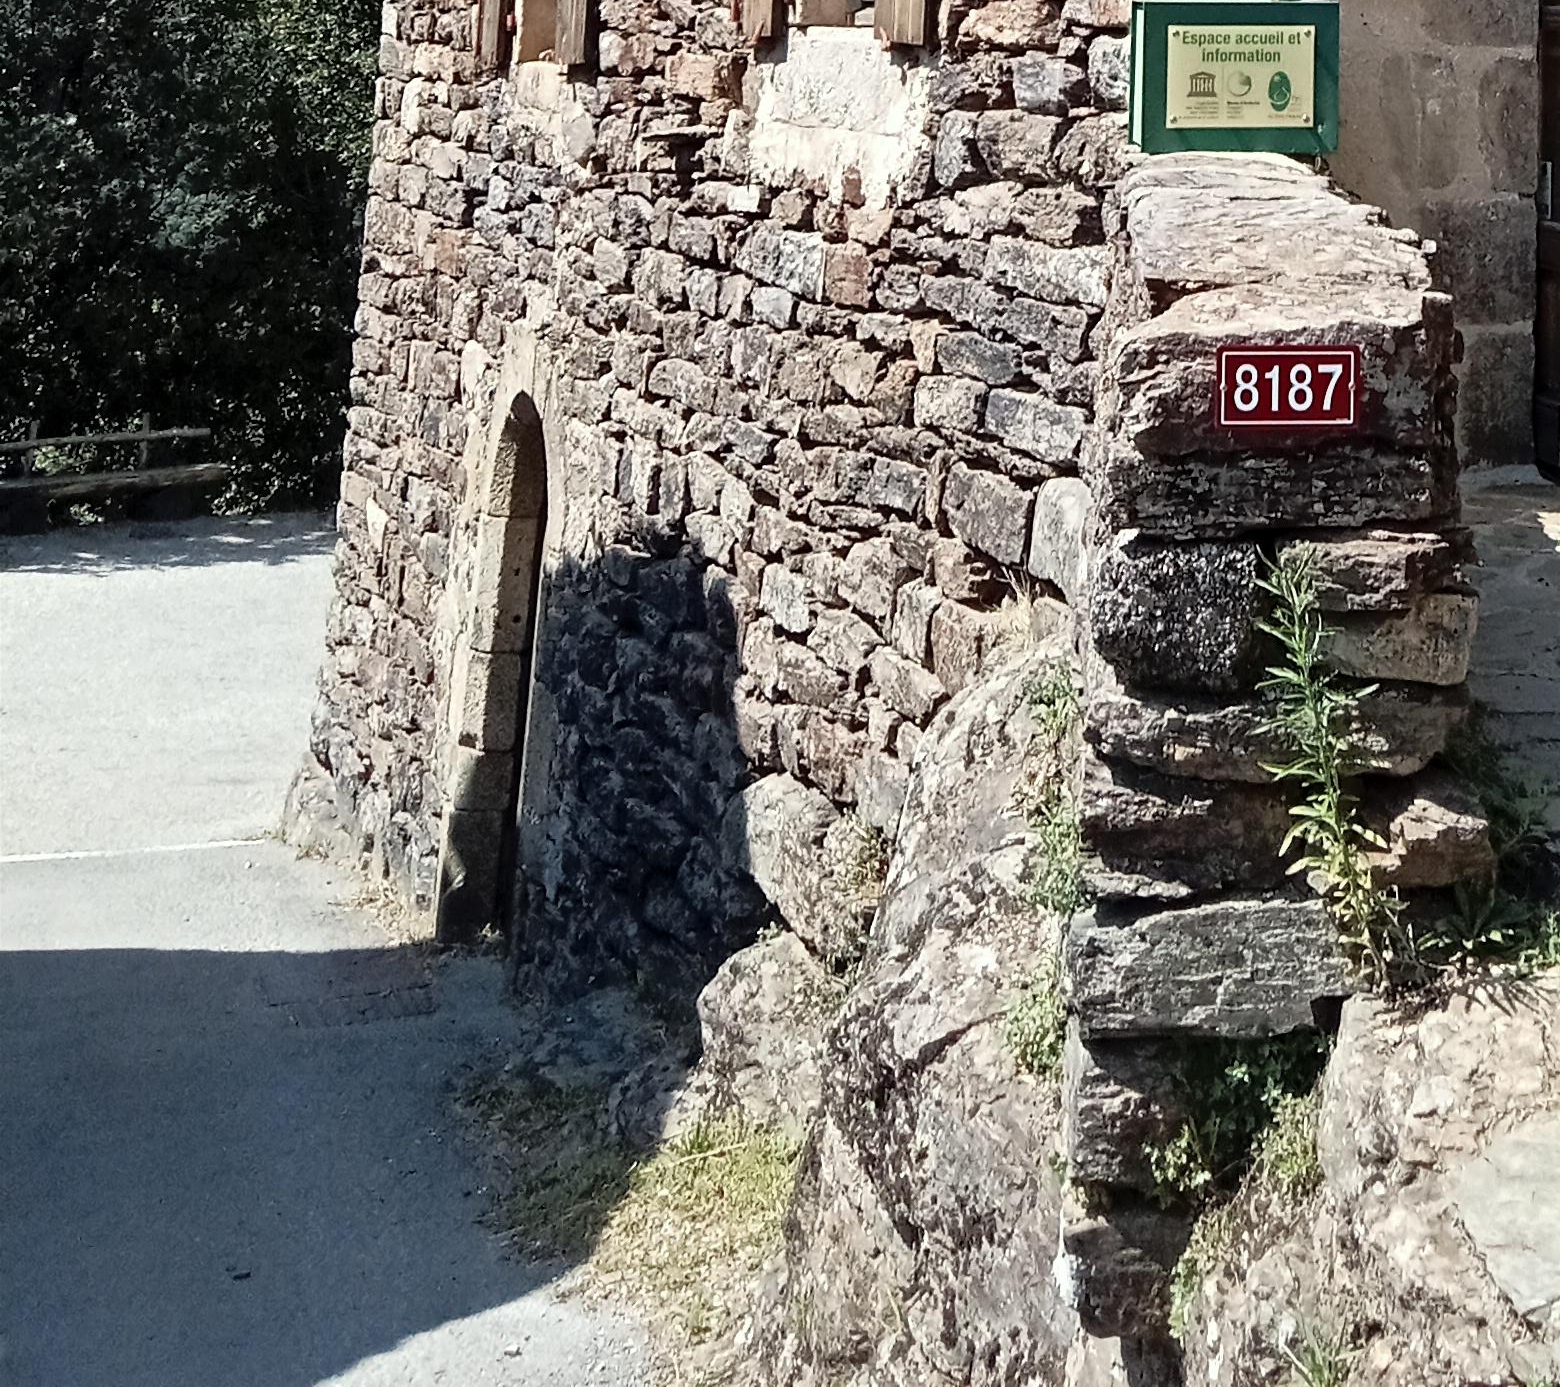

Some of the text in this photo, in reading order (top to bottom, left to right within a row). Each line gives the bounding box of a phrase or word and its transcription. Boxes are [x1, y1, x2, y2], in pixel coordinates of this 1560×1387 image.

[1182, 30, 1301, 46] Espace accueil et
[1202, 48, 1281, 63] information
[1233, 363, 1343, 412] 8187
